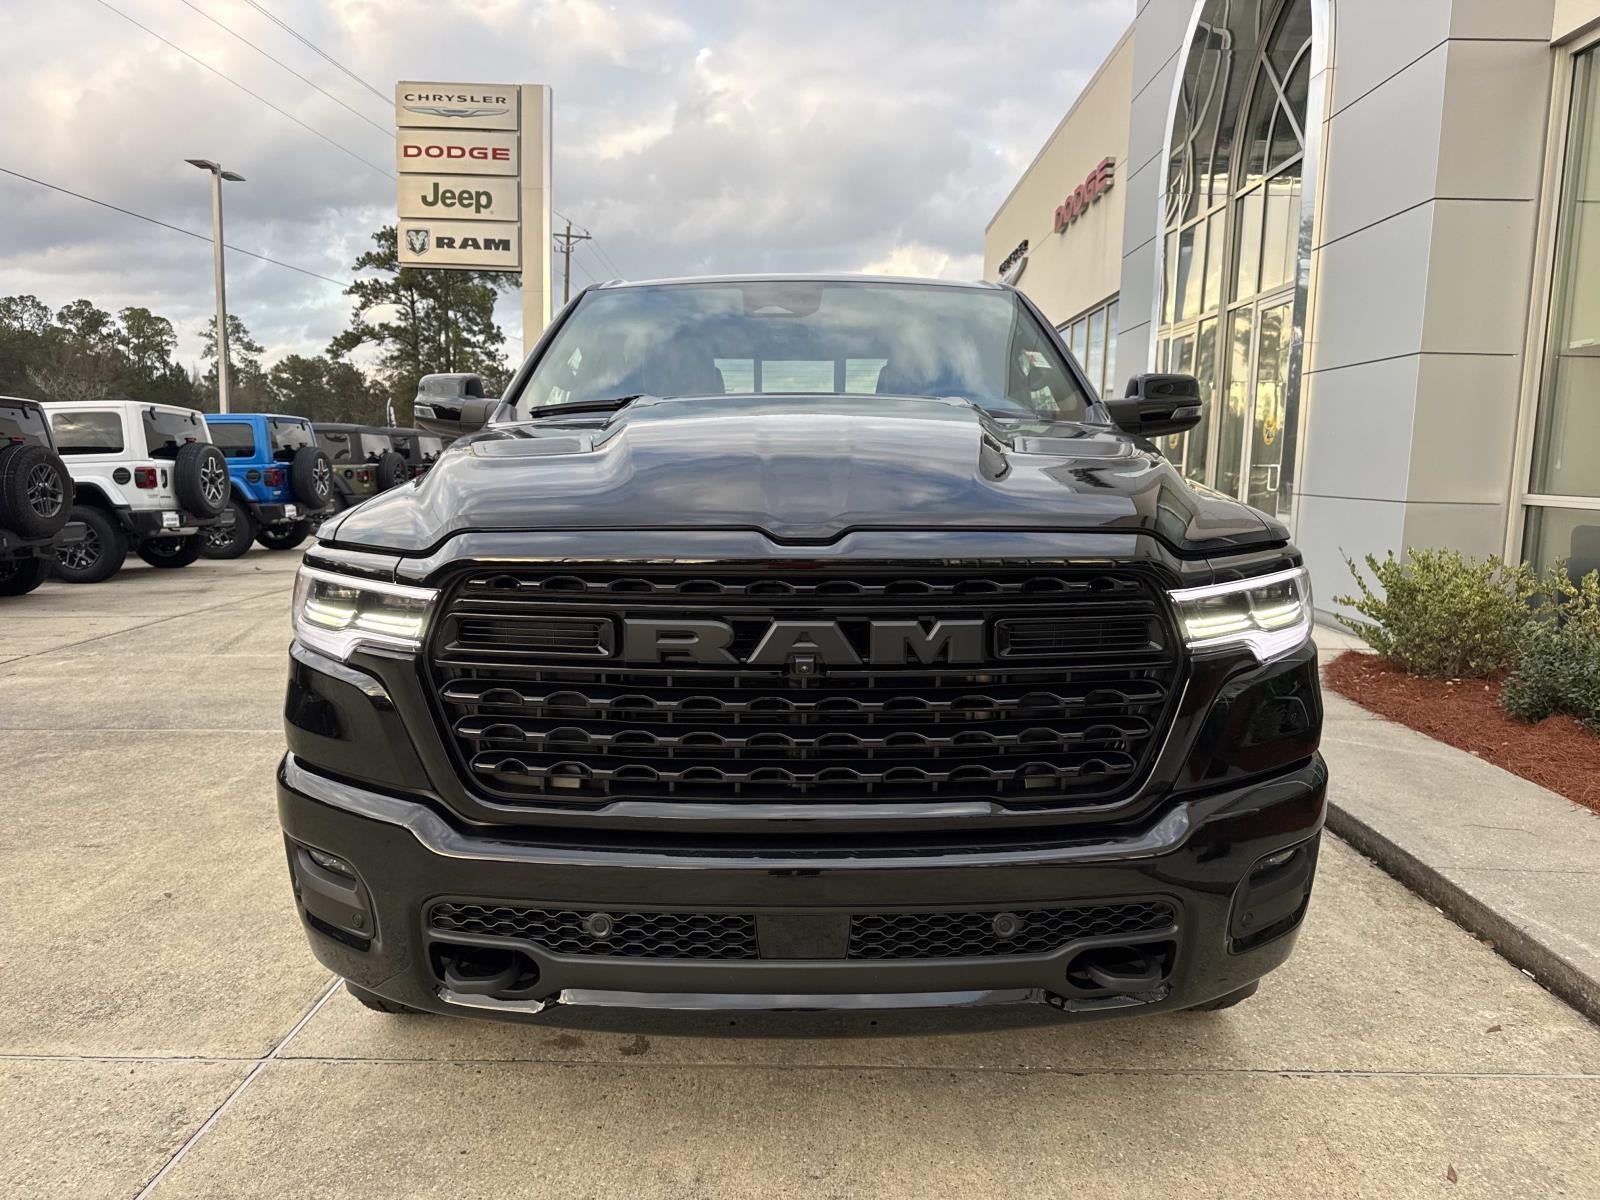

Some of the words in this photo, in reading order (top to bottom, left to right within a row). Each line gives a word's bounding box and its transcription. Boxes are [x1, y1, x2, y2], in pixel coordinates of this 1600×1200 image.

[403, 93, 507, 105] CHRYSLER
[402, 145, 511, 161] DODGE
[420, 182, 493, 214] Jeep
[1054, 156, 1116, 235] DODGE
[435, 236, 511, 252] RAM
[623, 617, 985, 665] RAM
